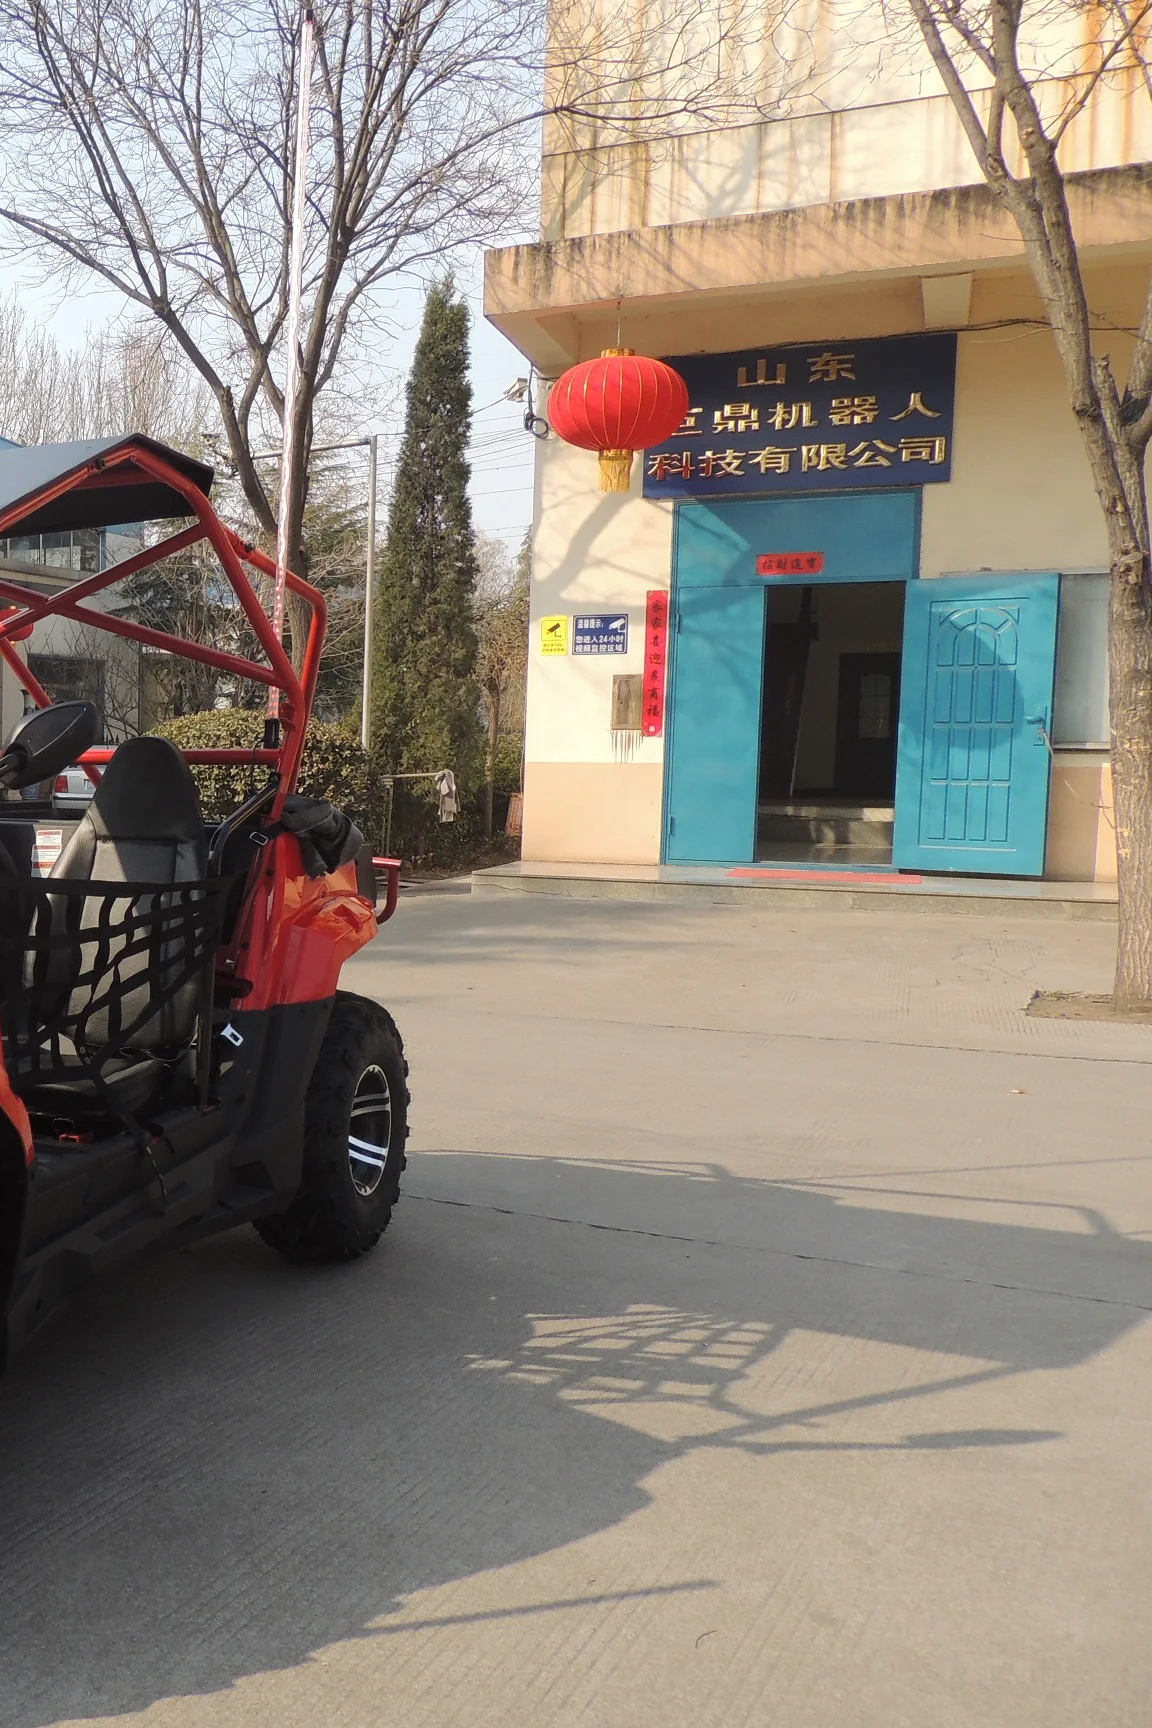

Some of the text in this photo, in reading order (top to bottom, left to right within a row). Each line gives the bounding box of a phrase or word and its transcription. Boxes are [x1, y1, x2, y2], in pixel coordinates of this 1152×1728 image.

[737, 352, 856, 388] 山东
[647, 436, 946, 481] 科技有限公司
[575, 644, 623, 653] 视频监控区域
